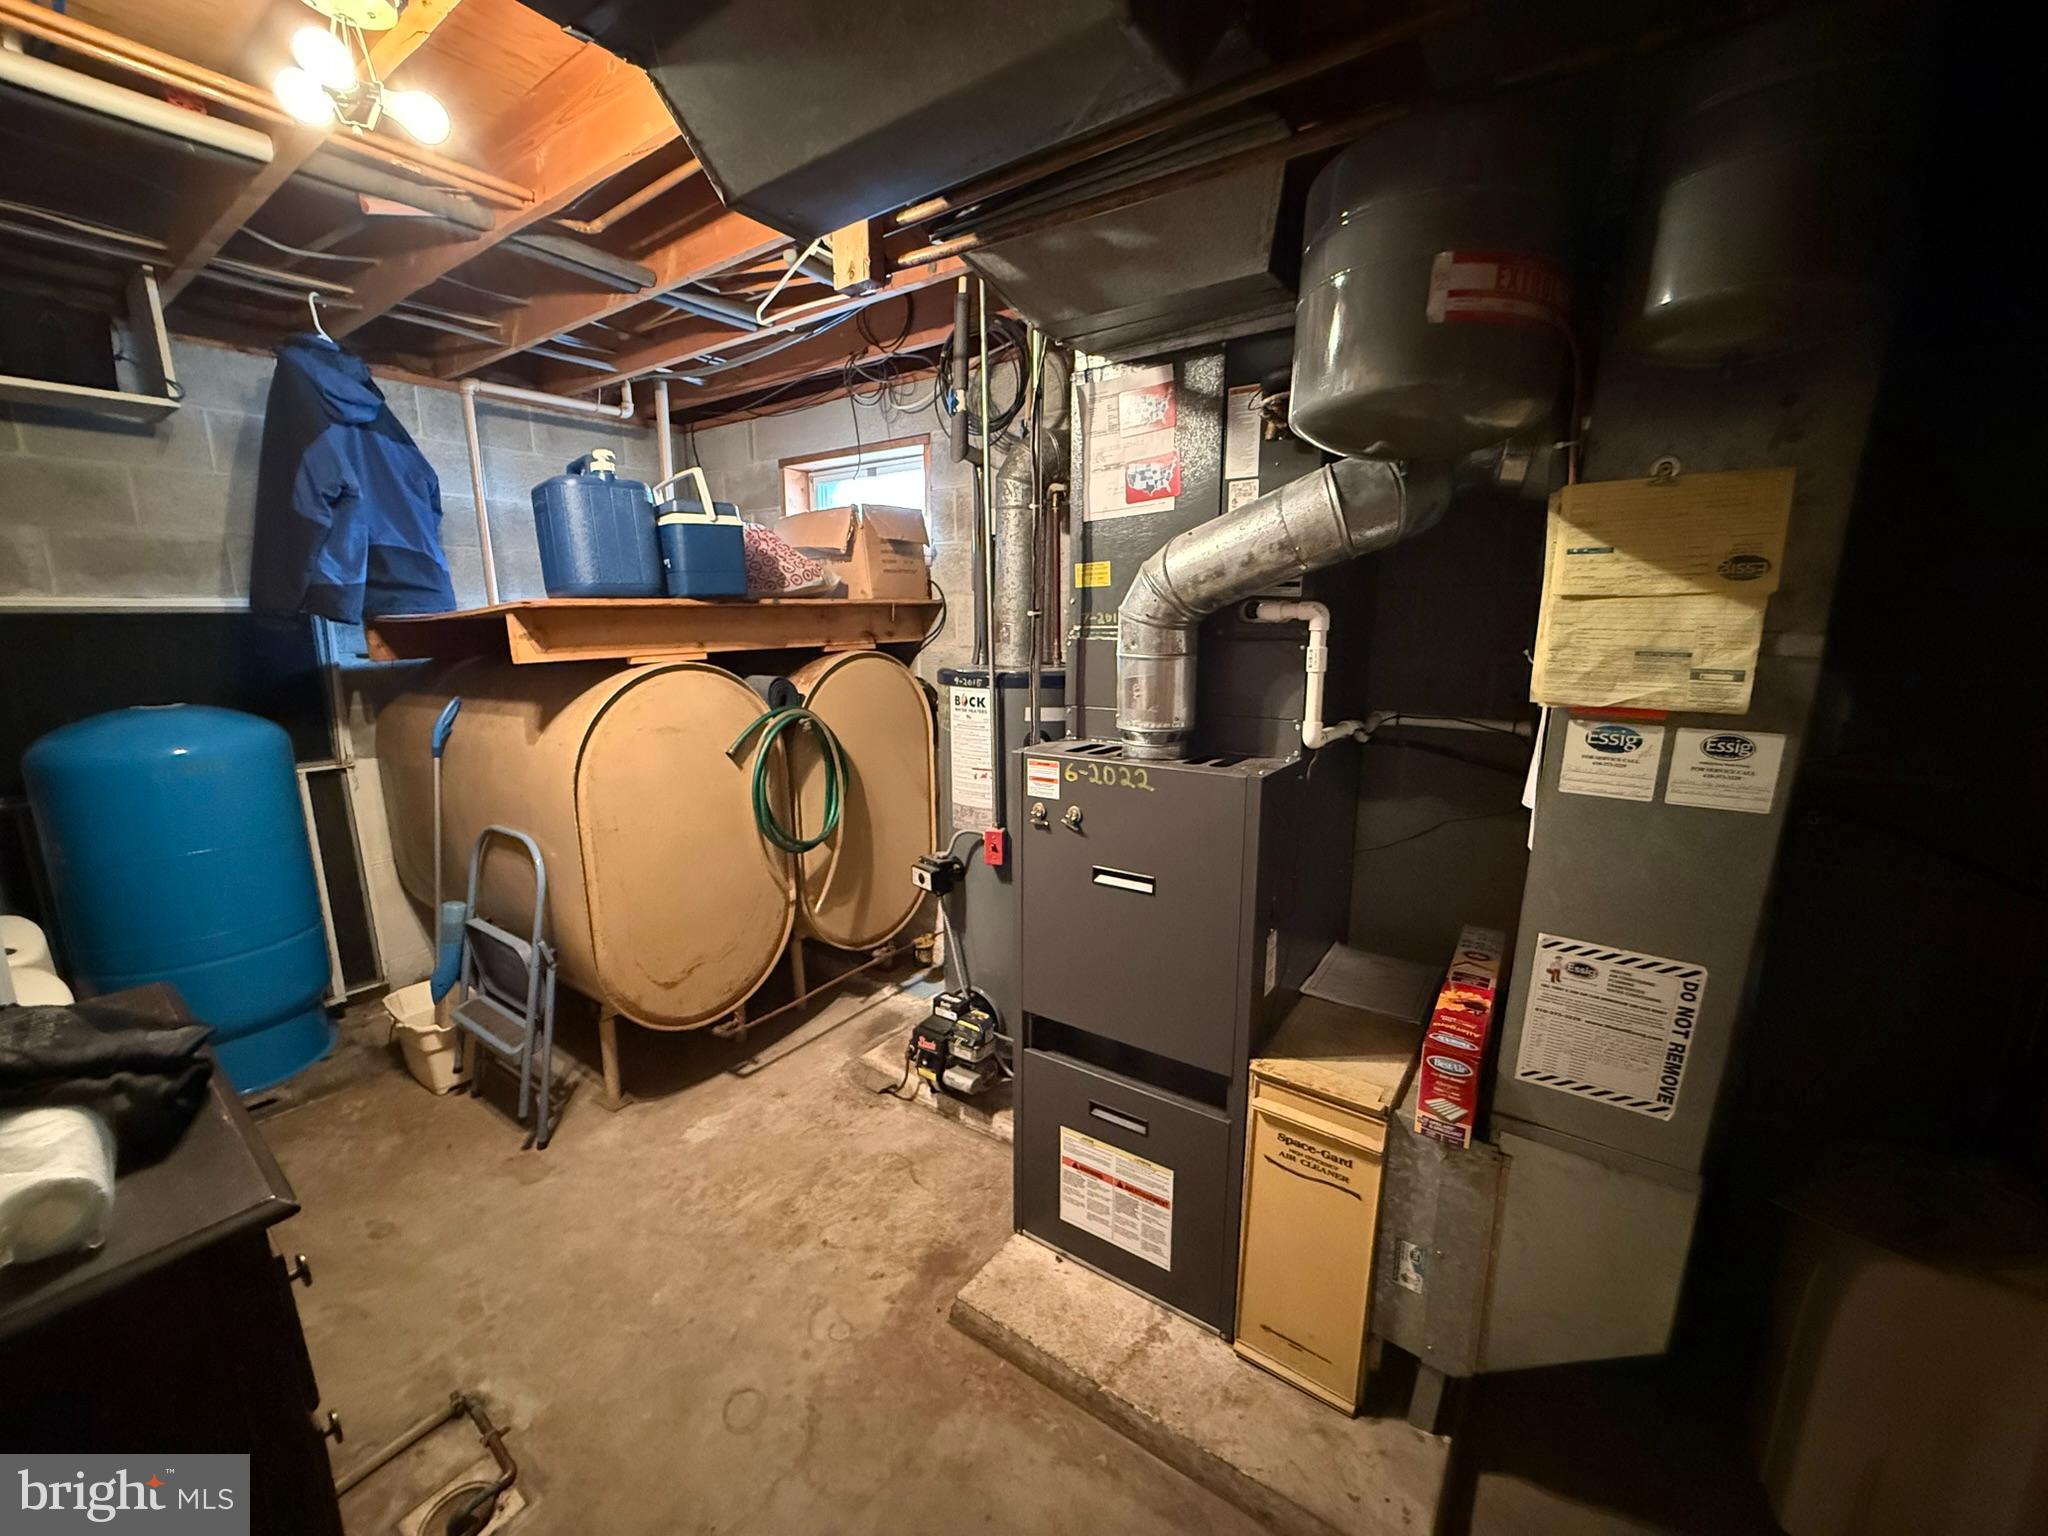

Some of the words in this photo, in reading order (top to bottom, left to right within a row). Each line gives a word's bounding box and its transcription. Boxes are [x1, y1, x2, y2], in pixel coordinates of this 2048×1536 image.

[954, 693, 986, 708] BOCK
[1586, 730, 1642, 751] Essig
[1705, 738, 1753, 756] Essig
[1064, 763, 1155, 792] 6-2022
[1680, 981, 1699, 1002] DO
[1672, 1006, 1695, 1039] NOT
[1656, 1042, 1687, 1105] REMOVE
[1277, 1132, 1353, 1169] Space-Gard
[1279, 1151, 1297, 1162] AIR
[1300, 1159, 1350, 1184] CLEANER
